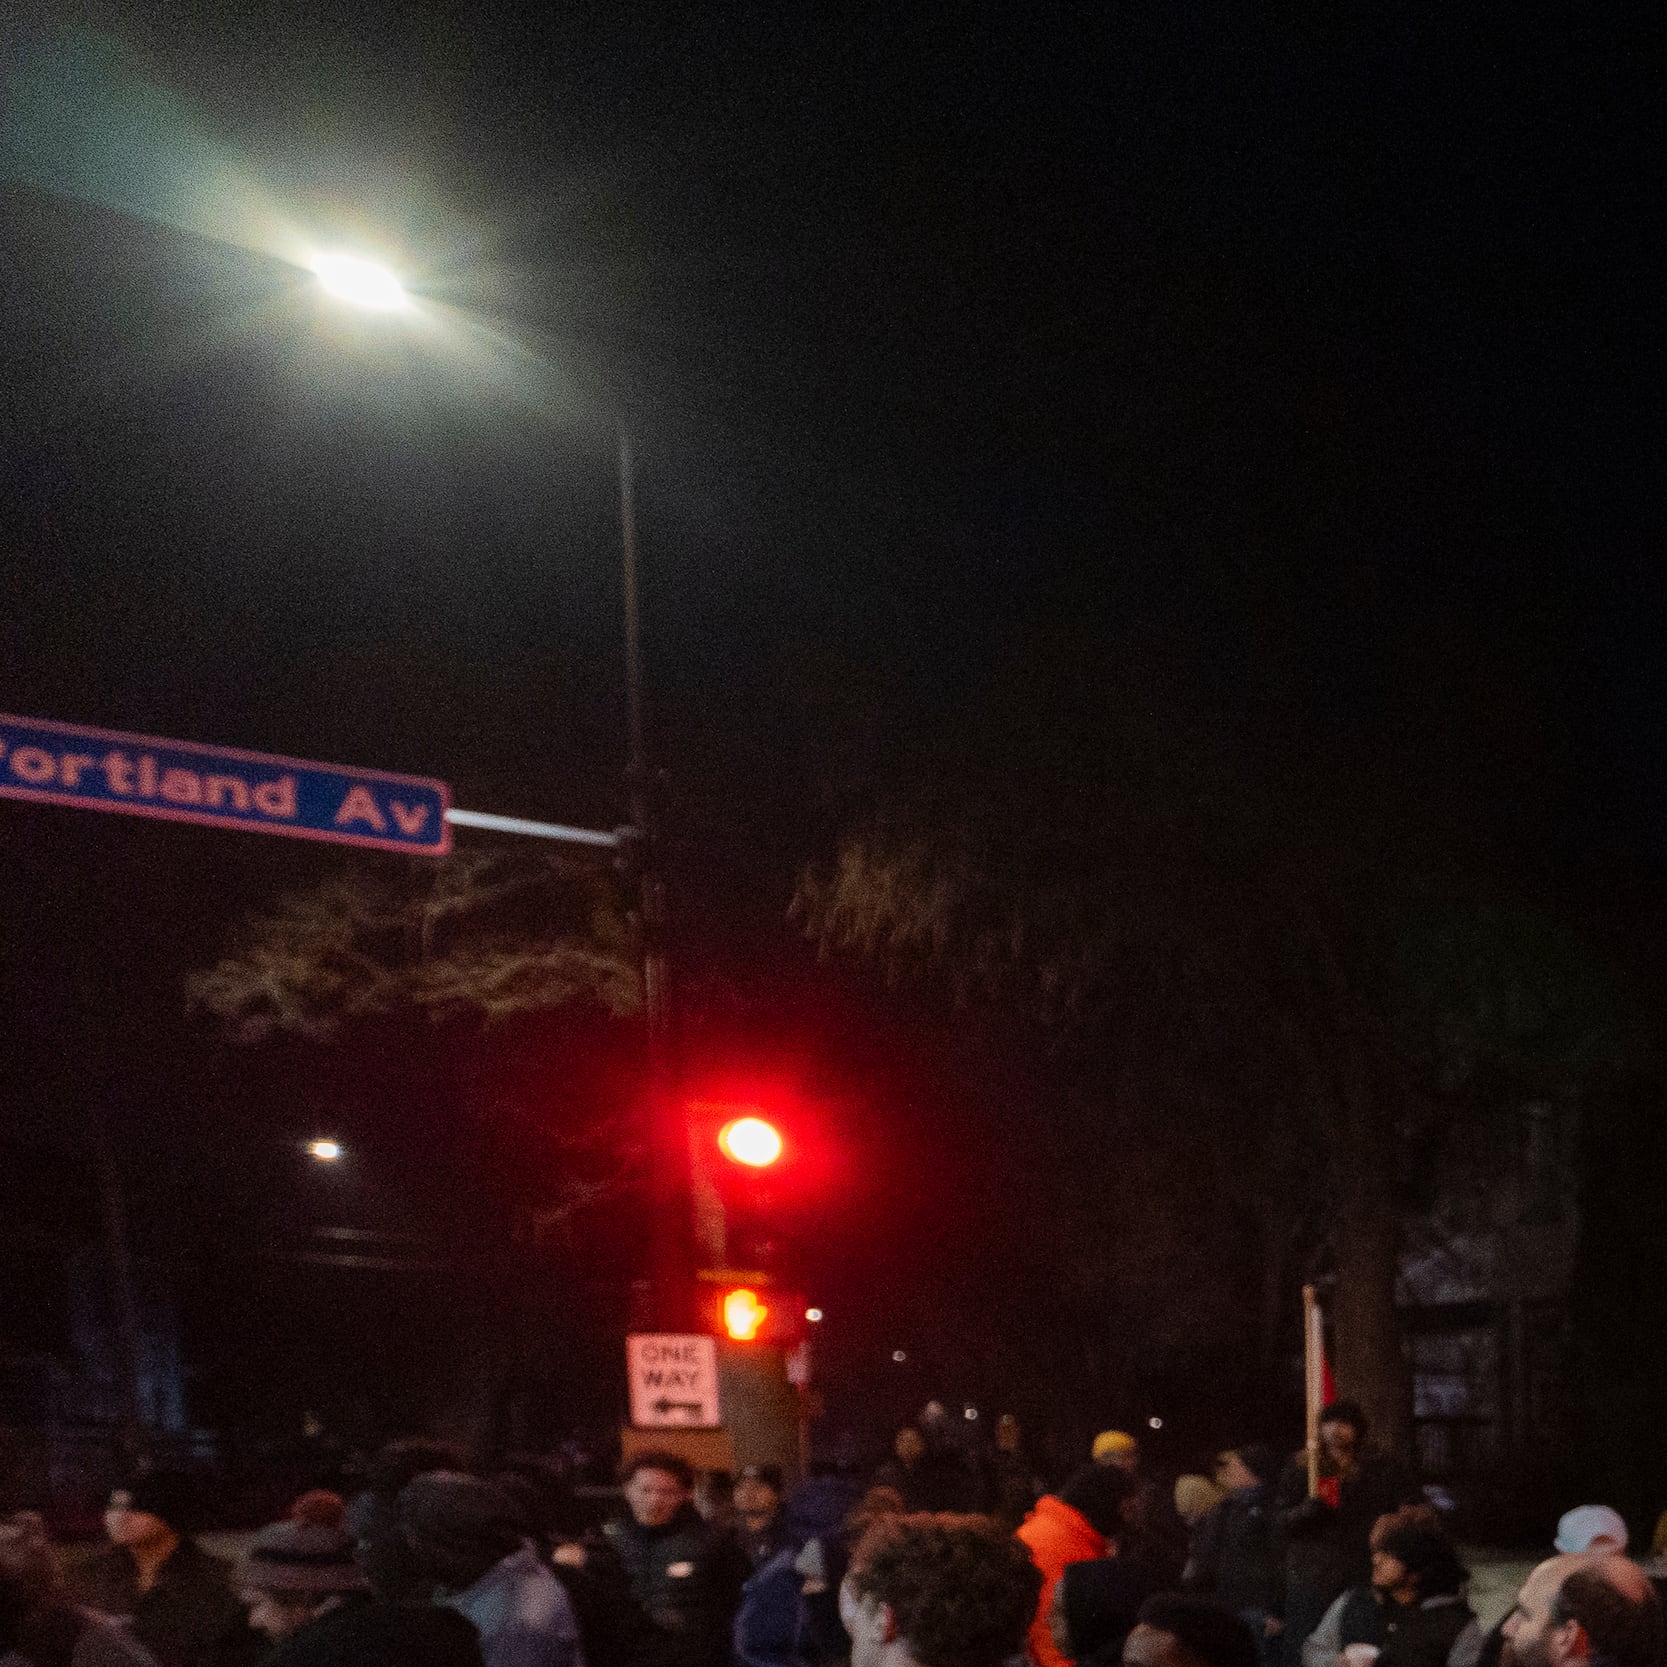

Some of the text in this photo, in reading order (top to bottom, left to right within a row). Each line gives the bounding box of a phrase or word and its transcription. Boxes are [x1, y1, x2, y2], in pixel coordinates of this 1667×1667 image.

[0, 739, 429, 835] ortland Av
[641, 1342, 698, 1363] ONE
[641, 1370, 699, 1388] WAY
